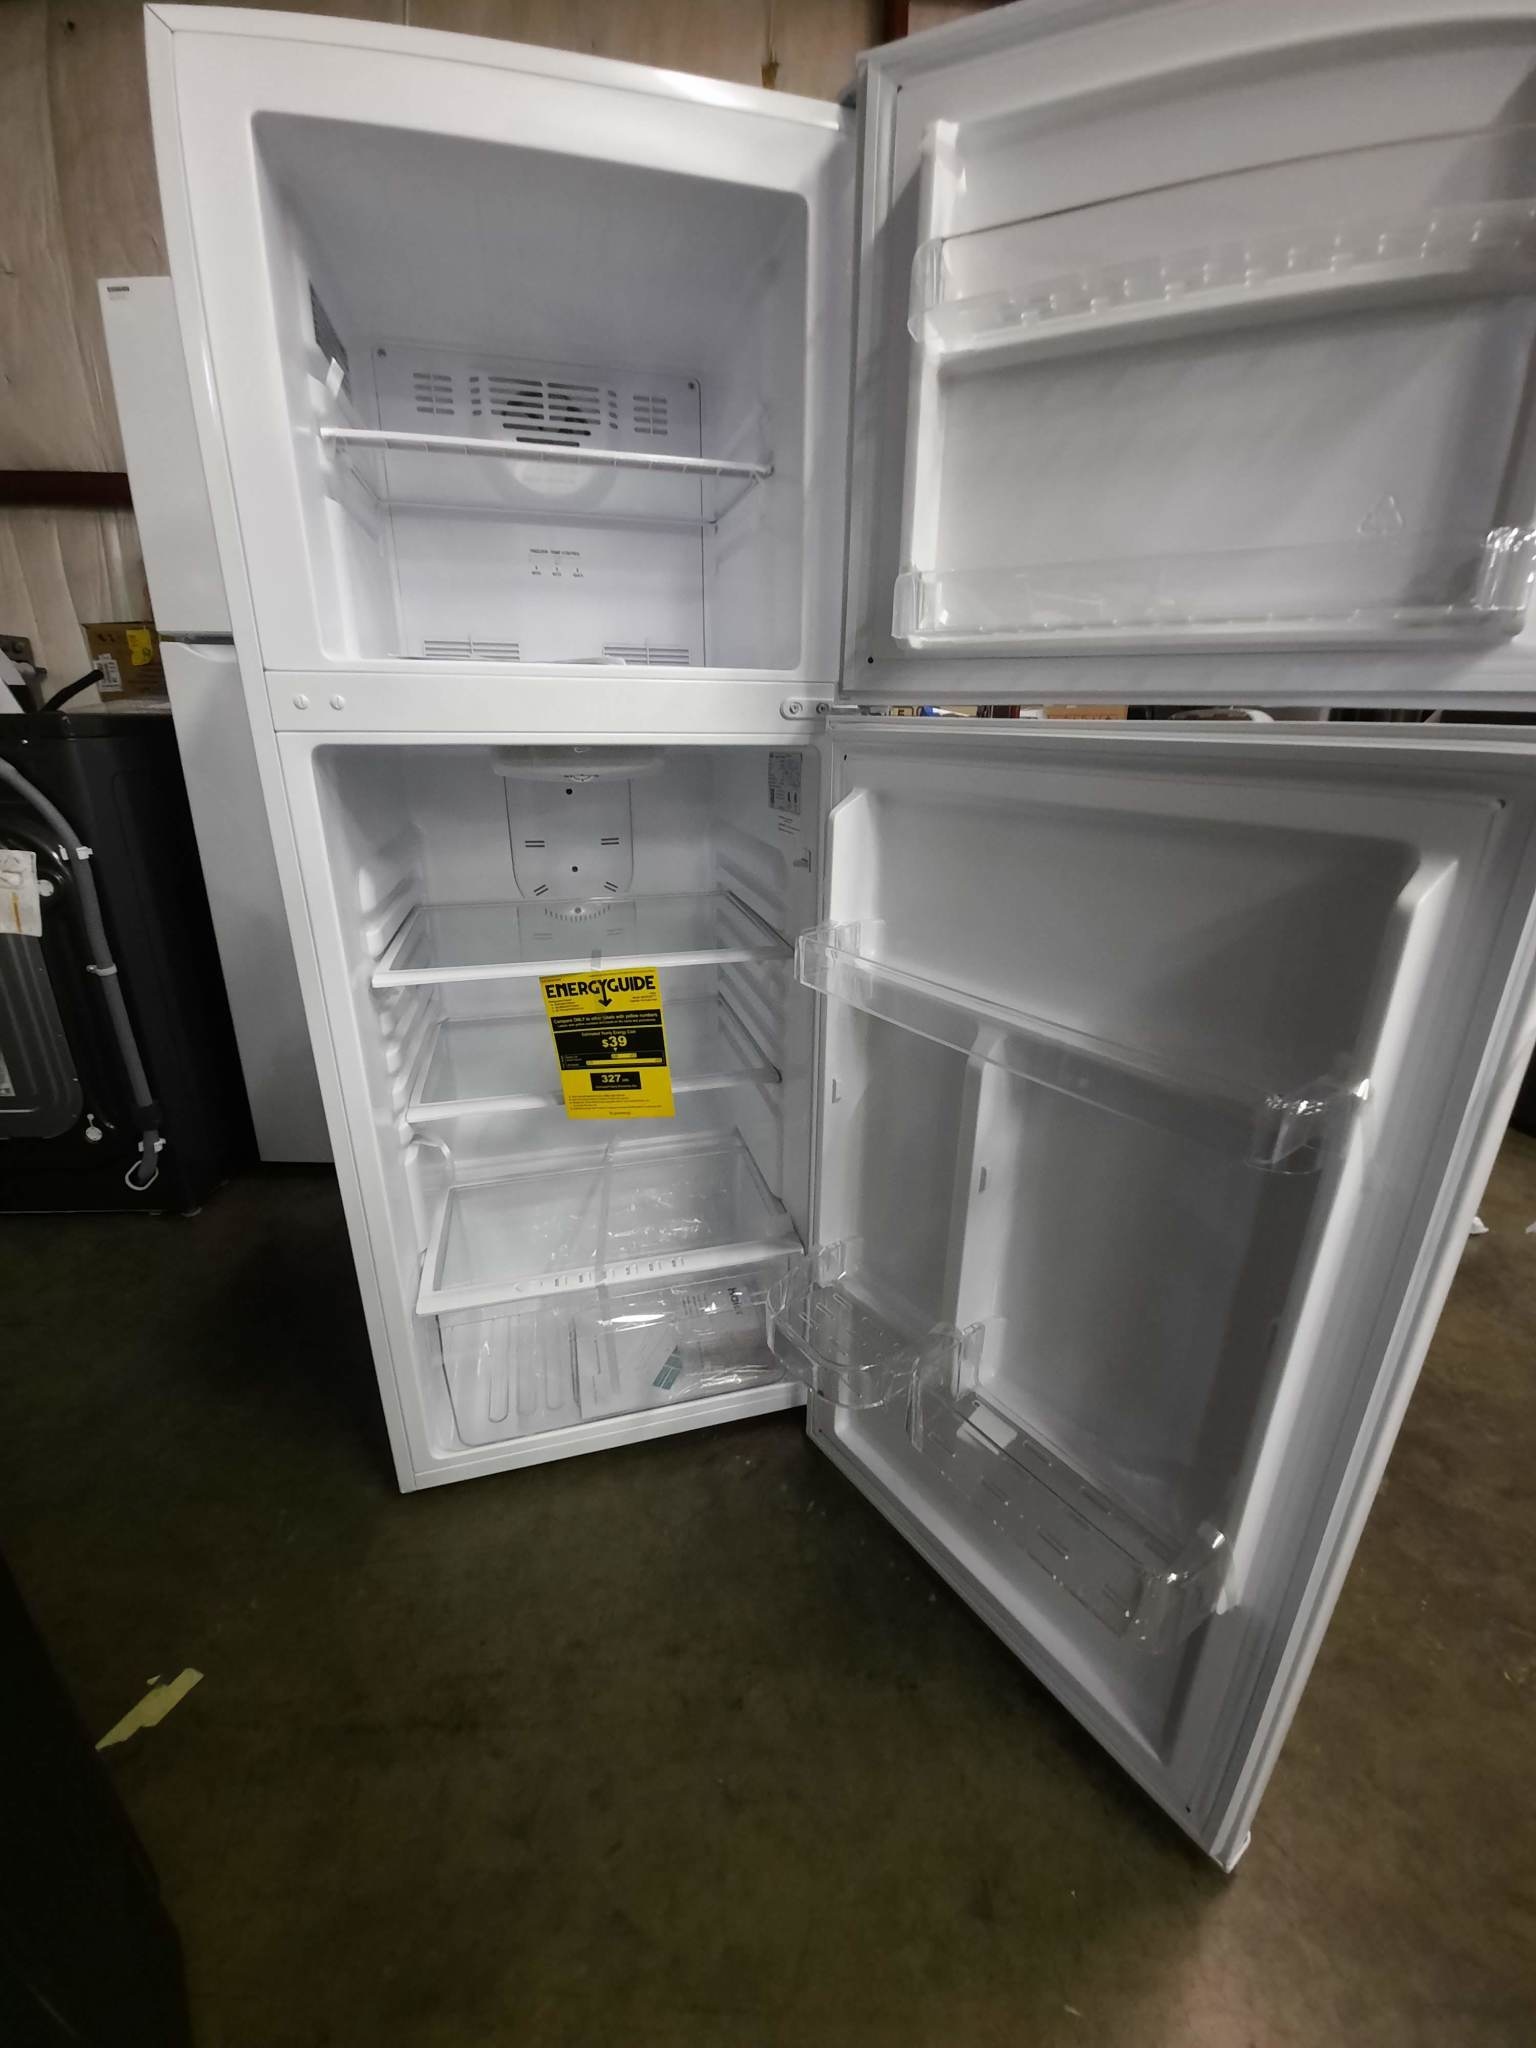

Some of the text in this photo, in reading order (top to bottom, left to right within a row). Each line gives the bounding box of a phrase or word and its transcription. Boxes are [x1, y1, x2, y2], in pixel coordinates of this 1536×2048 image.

[545, 975, 656, 999] ENERGYGUIDE
[602, 1036, 628, 1048] $39
[601, 1074, 621, 1083] 327
